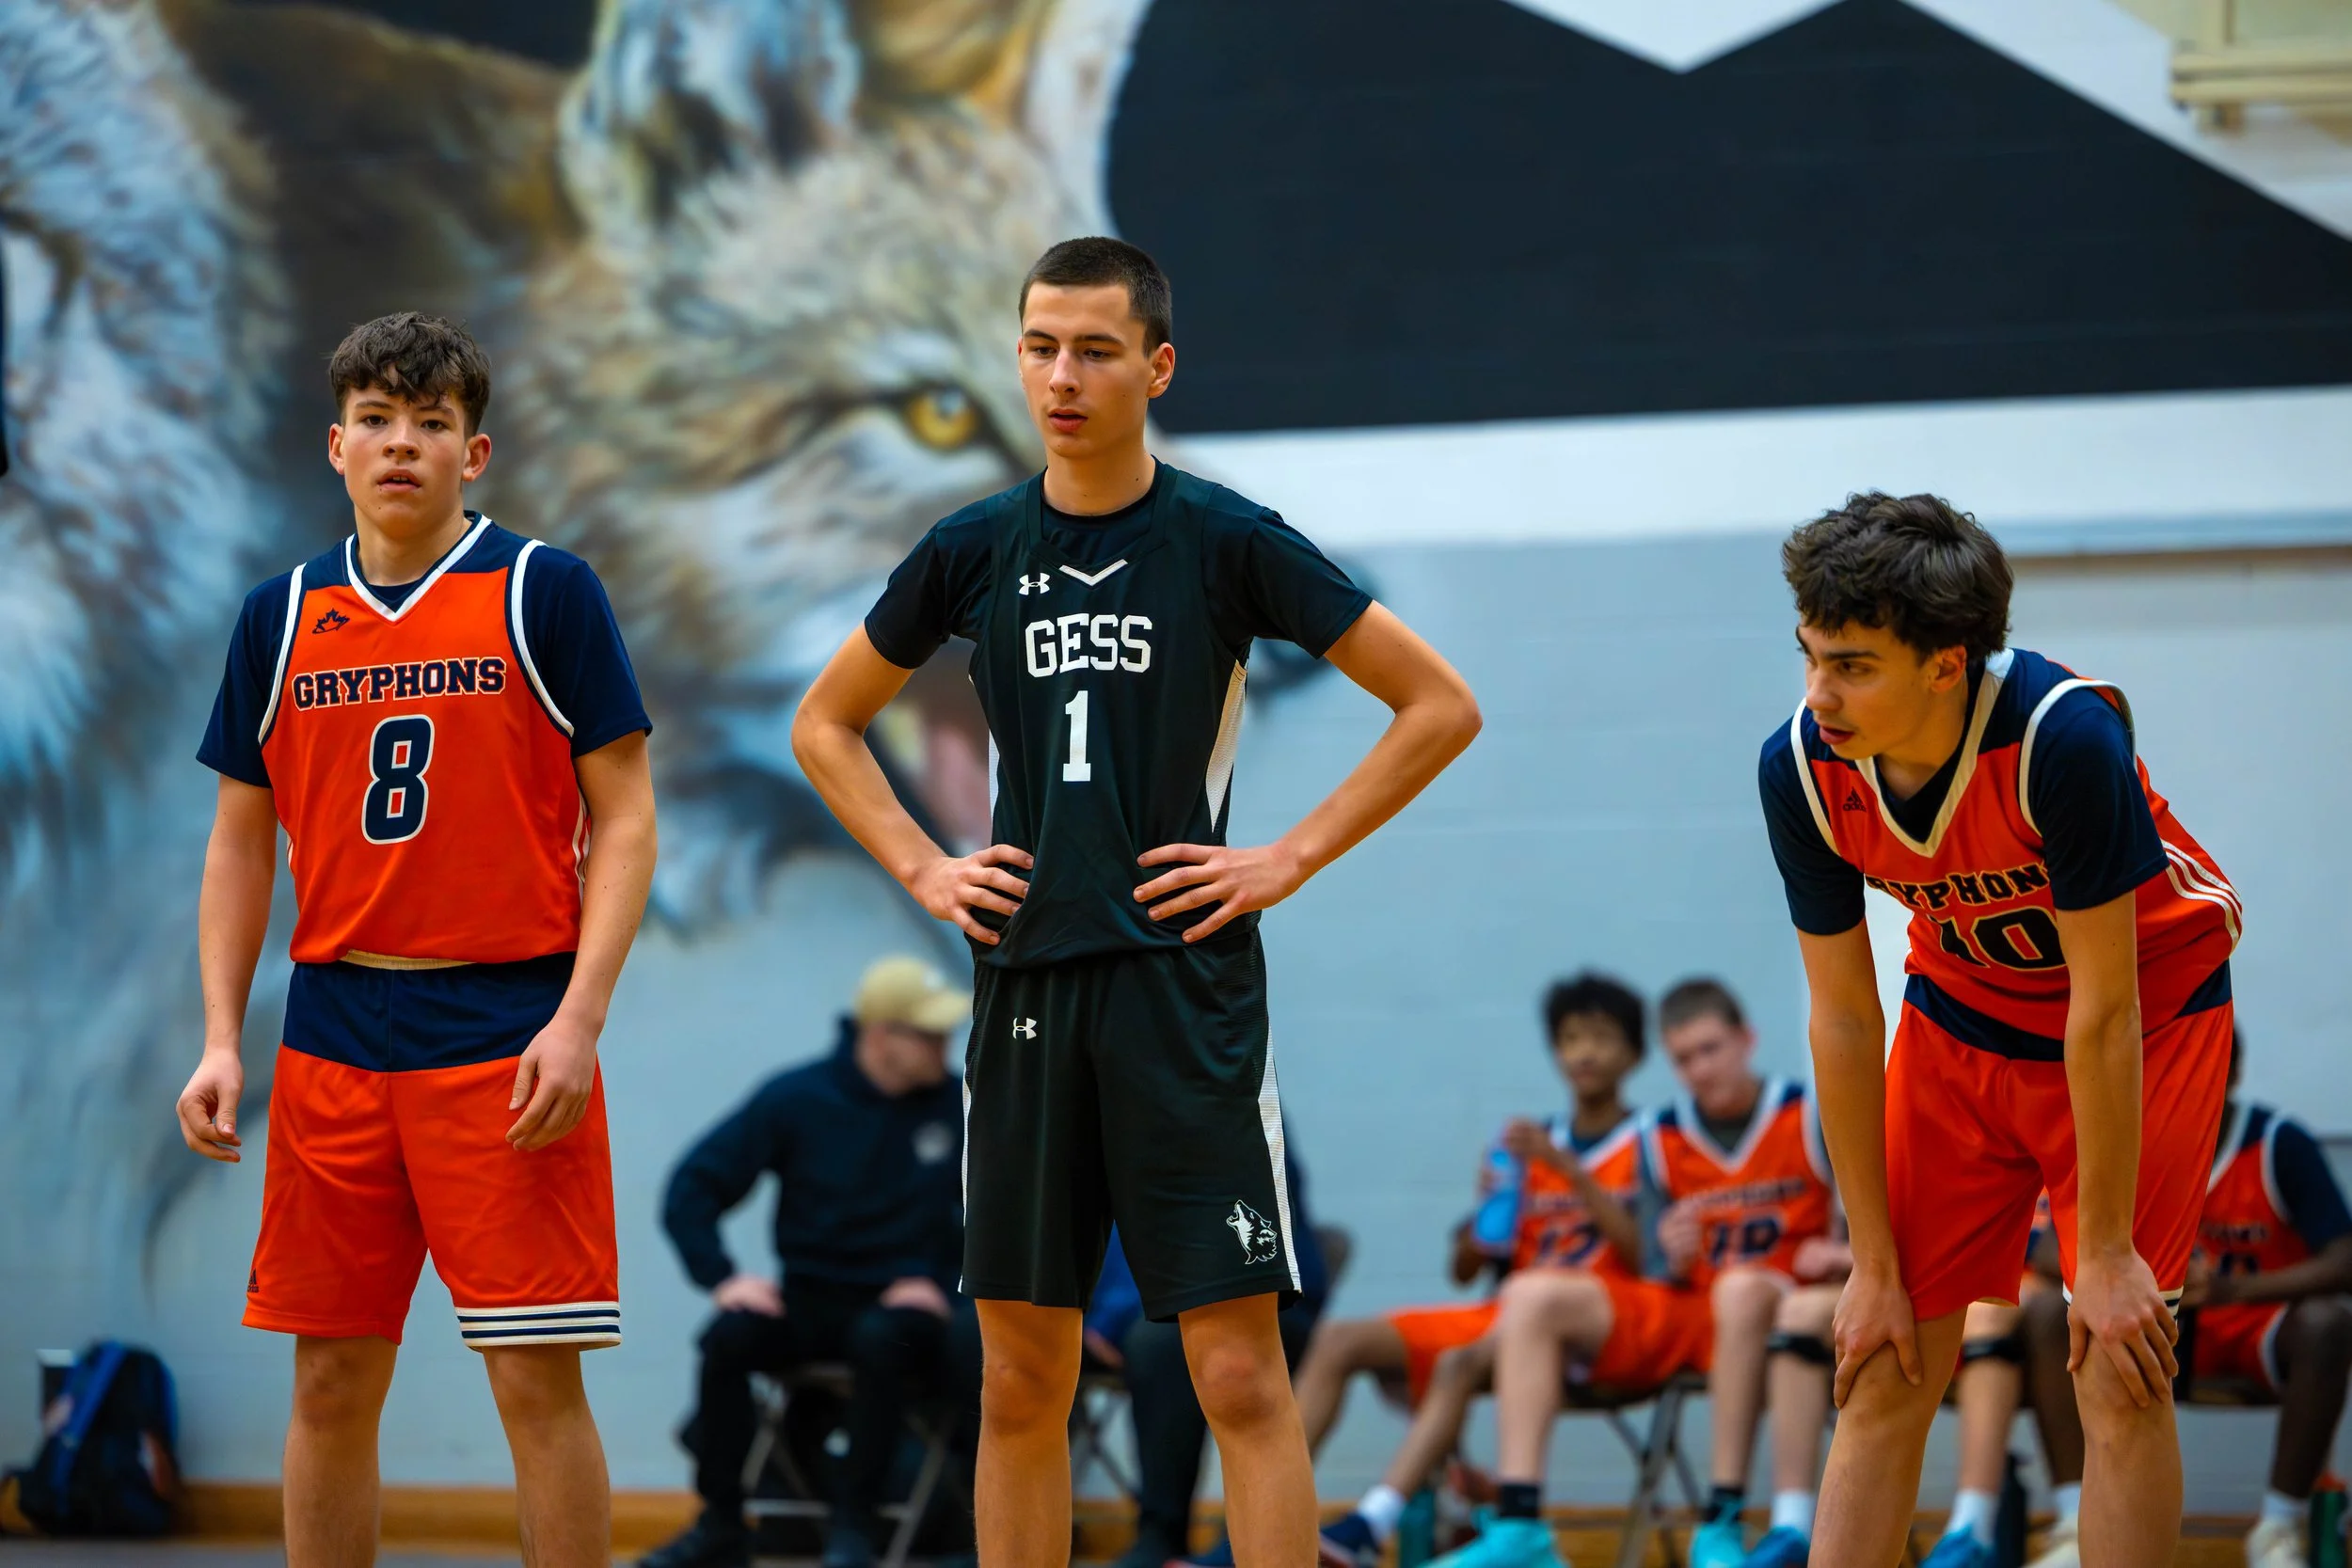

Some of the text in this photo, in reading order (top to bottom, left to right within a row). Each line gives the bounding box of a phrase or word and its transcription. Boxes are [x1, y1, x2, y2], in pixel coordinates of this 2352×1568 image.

[1025, 612, 1153, 678] GESS
[292, 657, 507, 712] GRYPHONS
[1062, 689, 1091, 782] 1
[361, 714, 435, 845] 8
[1926, 905, 2067, 972] 10
